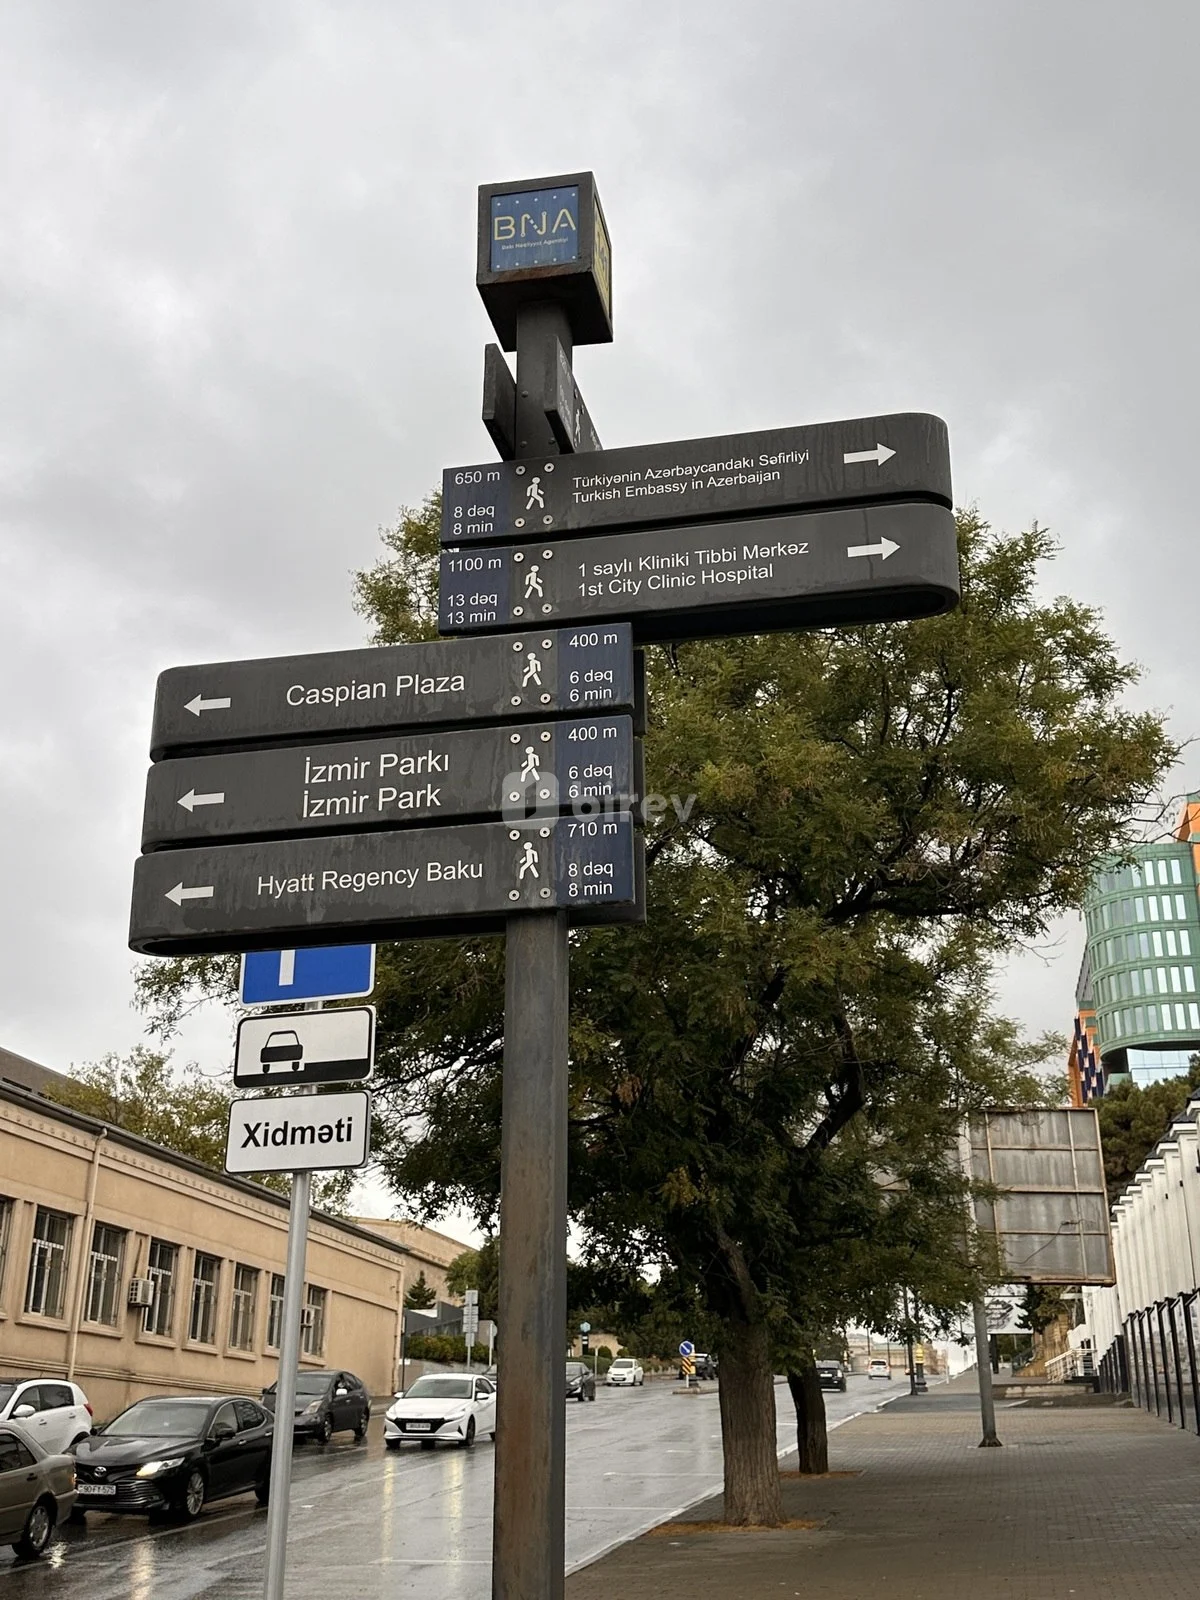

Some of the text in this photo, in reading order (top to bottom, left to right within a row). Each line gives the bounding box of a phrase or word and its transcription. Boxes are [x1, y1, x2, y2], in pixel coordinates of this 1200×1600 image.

[494, 208, 577, 241] BNA
[573, 450, 809, 488] Türkiyənin Azərbaycandakı Səfirliyi
[455, 470, 499, 485] 650 m
[573, 468, 779, 503] Turkish Embassy in Azerbaijan
[454, 505, 494, 518] 8 dəq
[454, 521, 492, 534] 8 min
[448, 557, 501, 573] 1100 m
[579, 542, 809, 577] 1 saylı Kliniki Tibbi Mərkəz
[578, 564, 772, 596] 1st City Clinic Hospital
[448, 593, 497, 606] 13 dəq
[448, 610, 495, 624] 13 min
[570, 633, 617, 647] 400 m
[570, 670, 612, 683] 6 dəq
[287, 675, 464, 706] Caspian Plaza
[570, 687, 611, 701] 6 min
[569, 727, 616, 741] 400 m
[305, 750, 448, 783] İzmir Parkı
[569, 765, 612, 779] 6 dəq
[569, 783, 611, 798] 6 min
[303, 784, 440, 817] İzmir Park
[568, 822, 617, 837] 710 m
[569, 862, 612, 877] 8 dəq
[258, 861, 482, 898] Hyatt Regency Baku
[569, 881, 612, 896] 8 min
[240, 1116, 353, 1149] Xidməti
